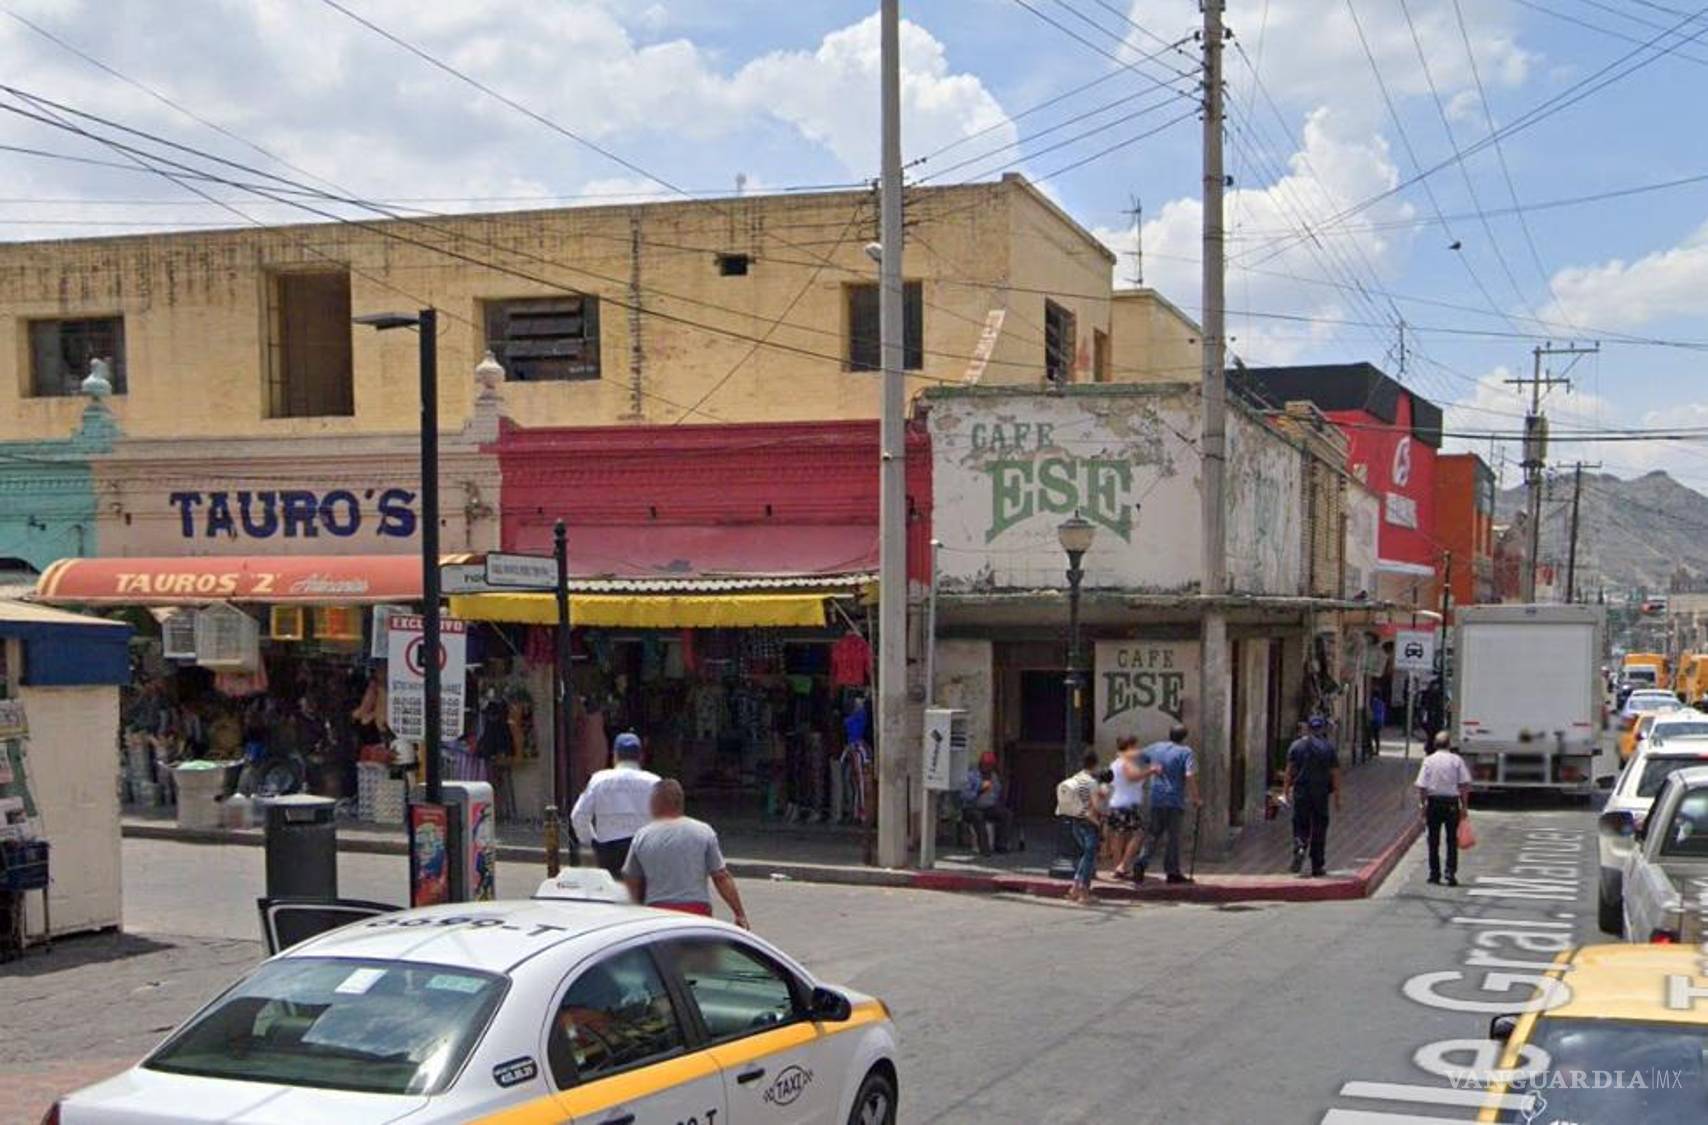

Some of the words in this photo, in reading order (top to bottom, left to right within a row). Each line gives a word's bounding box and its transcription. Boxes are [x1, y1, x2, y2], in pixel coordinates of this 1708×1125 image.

[970, 422, 1055, 450] CAFE
[169, 488, 417, 539] TAURO'S
[983, 457, 1133, 544] ESE
[114, 573, 240, 593] TAUROS
[391, 616, 464, 633] EXCLIVO
[1118, 648, 1174, 668] CAFE
[1102, 671, 1184, 723] ESE
[776, 1072, 803, 1100] TAXI
